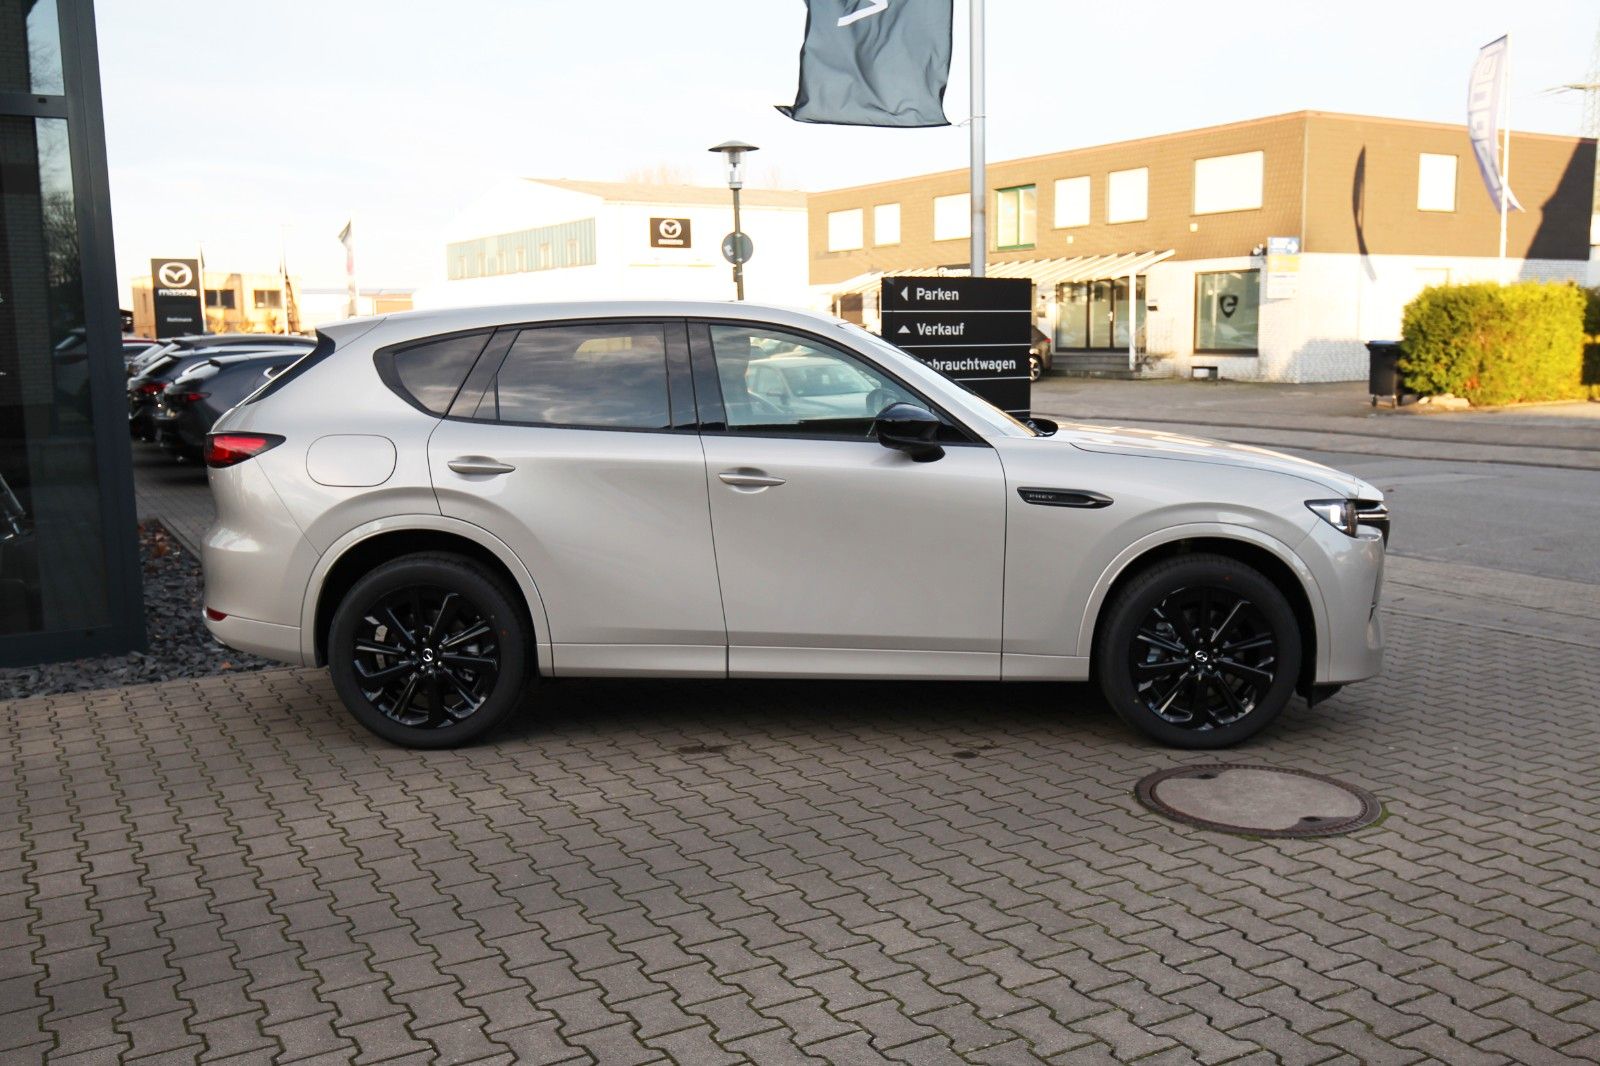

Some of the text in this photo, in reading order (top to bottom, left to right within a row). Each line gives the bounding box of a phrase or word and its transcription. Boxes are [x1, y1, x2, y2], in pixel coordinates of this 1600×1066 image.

[916, 288, 959, 300] Parken
[917, 322, 965, 336] Verkauf
[921, 358, 1016, 372] brauchtwagen
